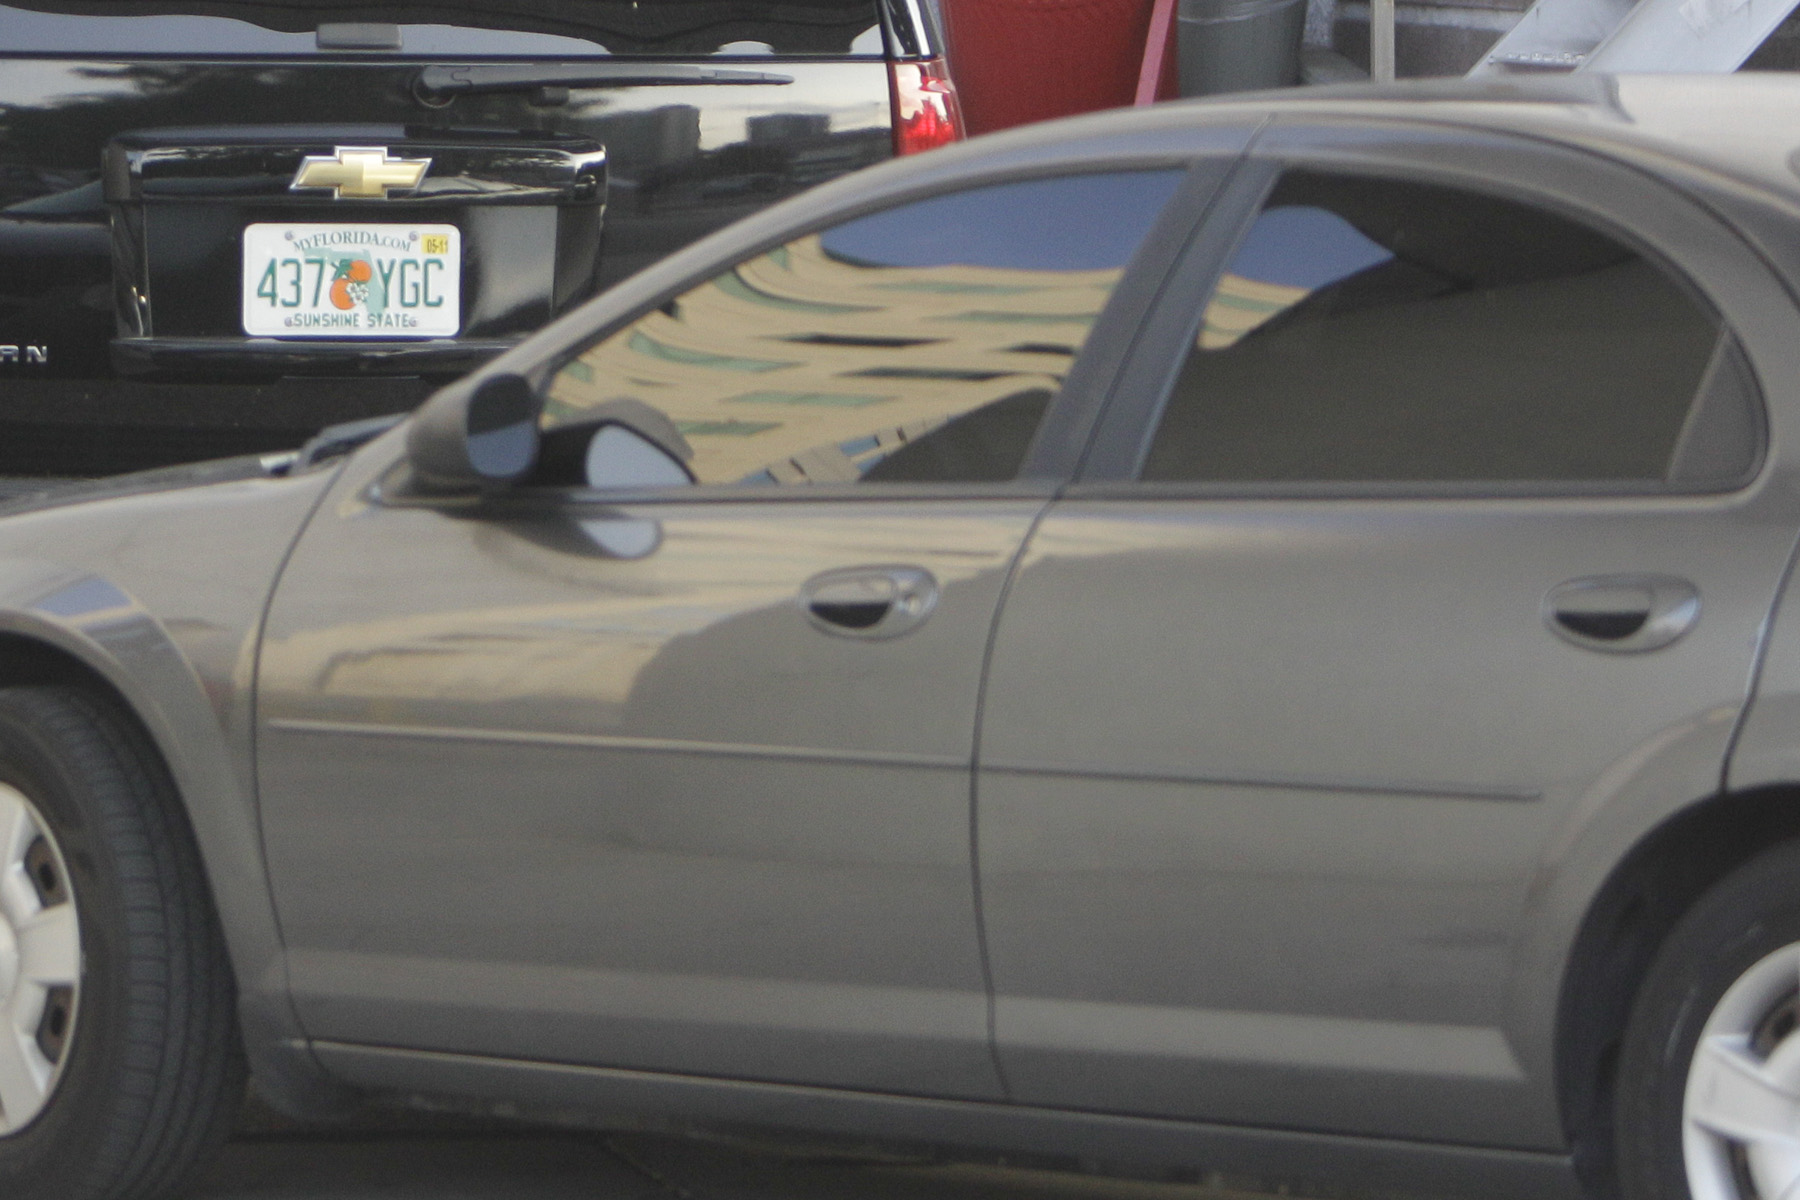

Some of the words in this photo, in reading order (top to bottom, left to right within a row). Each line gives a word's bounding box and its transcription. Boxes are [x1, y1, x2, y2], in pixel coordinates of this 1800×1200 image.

[293, 230, 412, 252] MYFLORIDA.COM
[256, 257, 326, 308] 437
[376, 257, 444, 308] YGC
[293, 313, 360, 328] SUNSHINE
[367, 313, 411, 328] STATE
